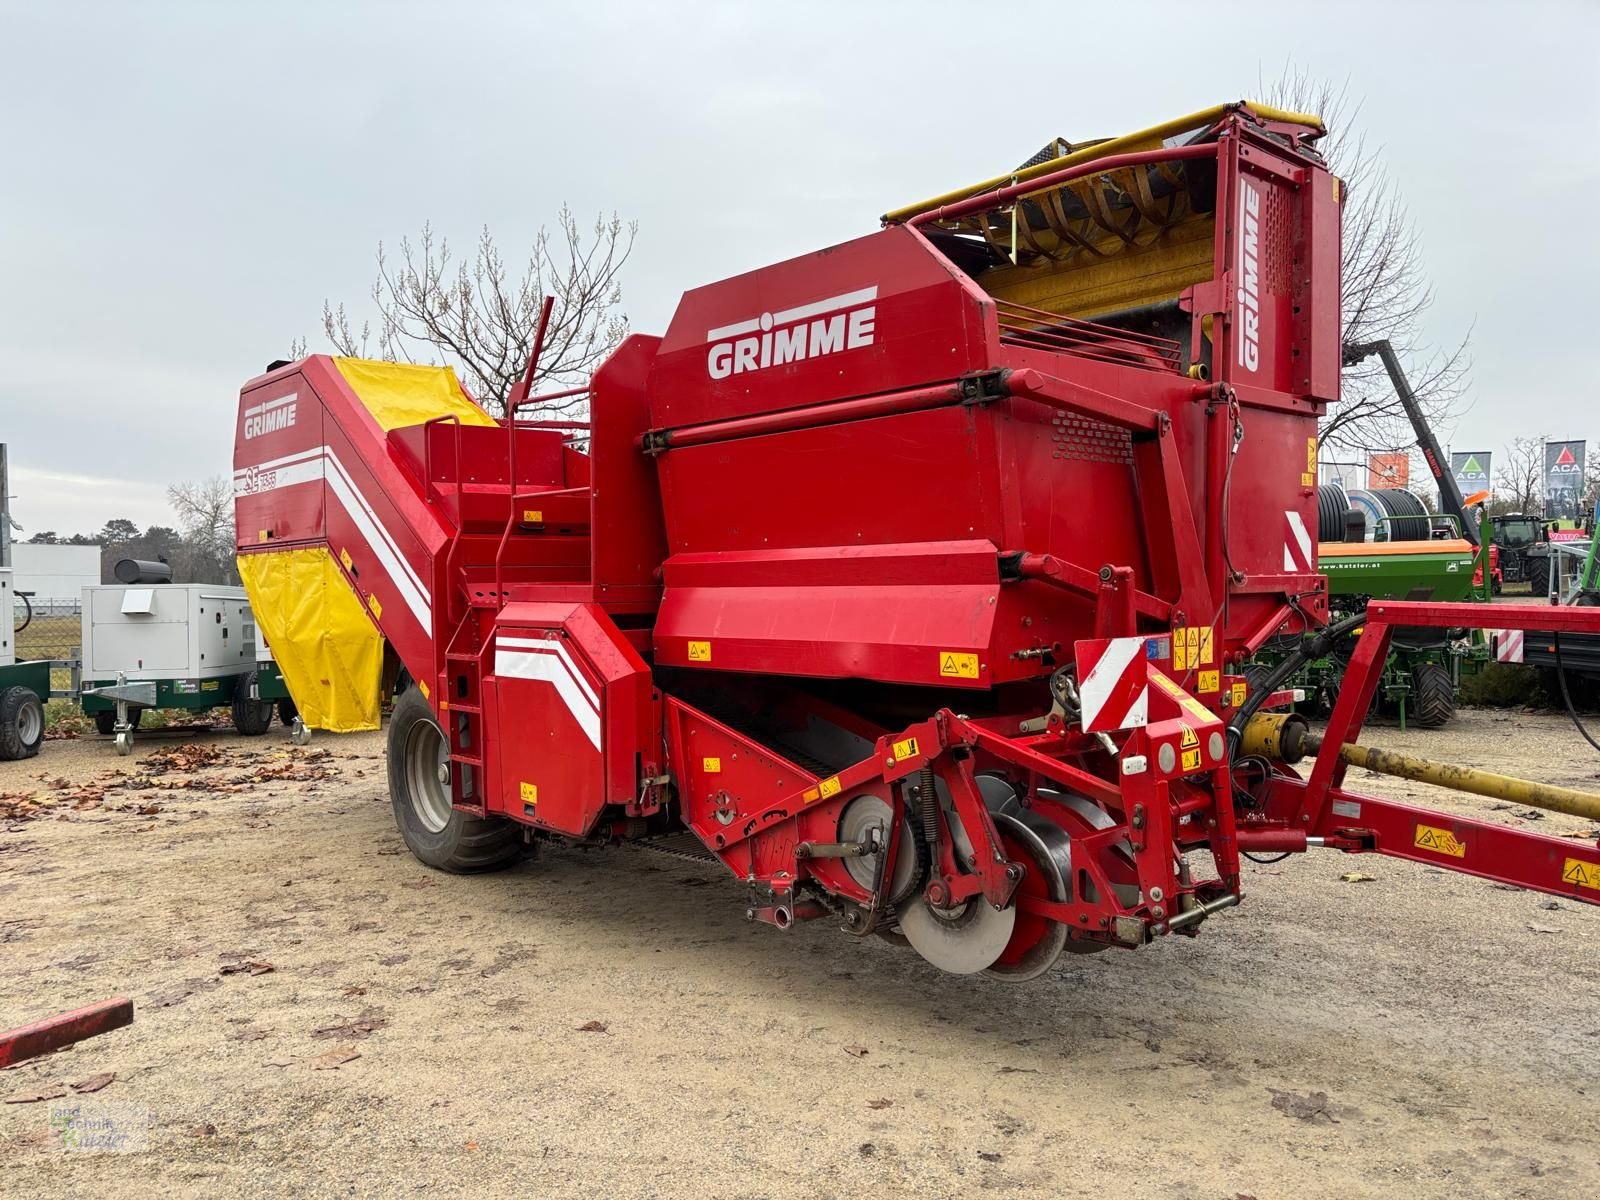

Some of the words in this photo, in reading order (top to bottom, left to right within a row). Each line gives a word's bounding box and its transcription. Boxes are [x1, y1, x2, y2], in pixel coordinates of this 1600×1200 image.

[1239, 179, 1260, 373] GRIMME
[707, 305, 876, 380] GRIMME
[244, 402, 297, 440] GRIMME
[245, 465, 259, 494] SE
[1456, 472, 1488, 480] ACA
[1549, 464, 1582, 473] ACA
